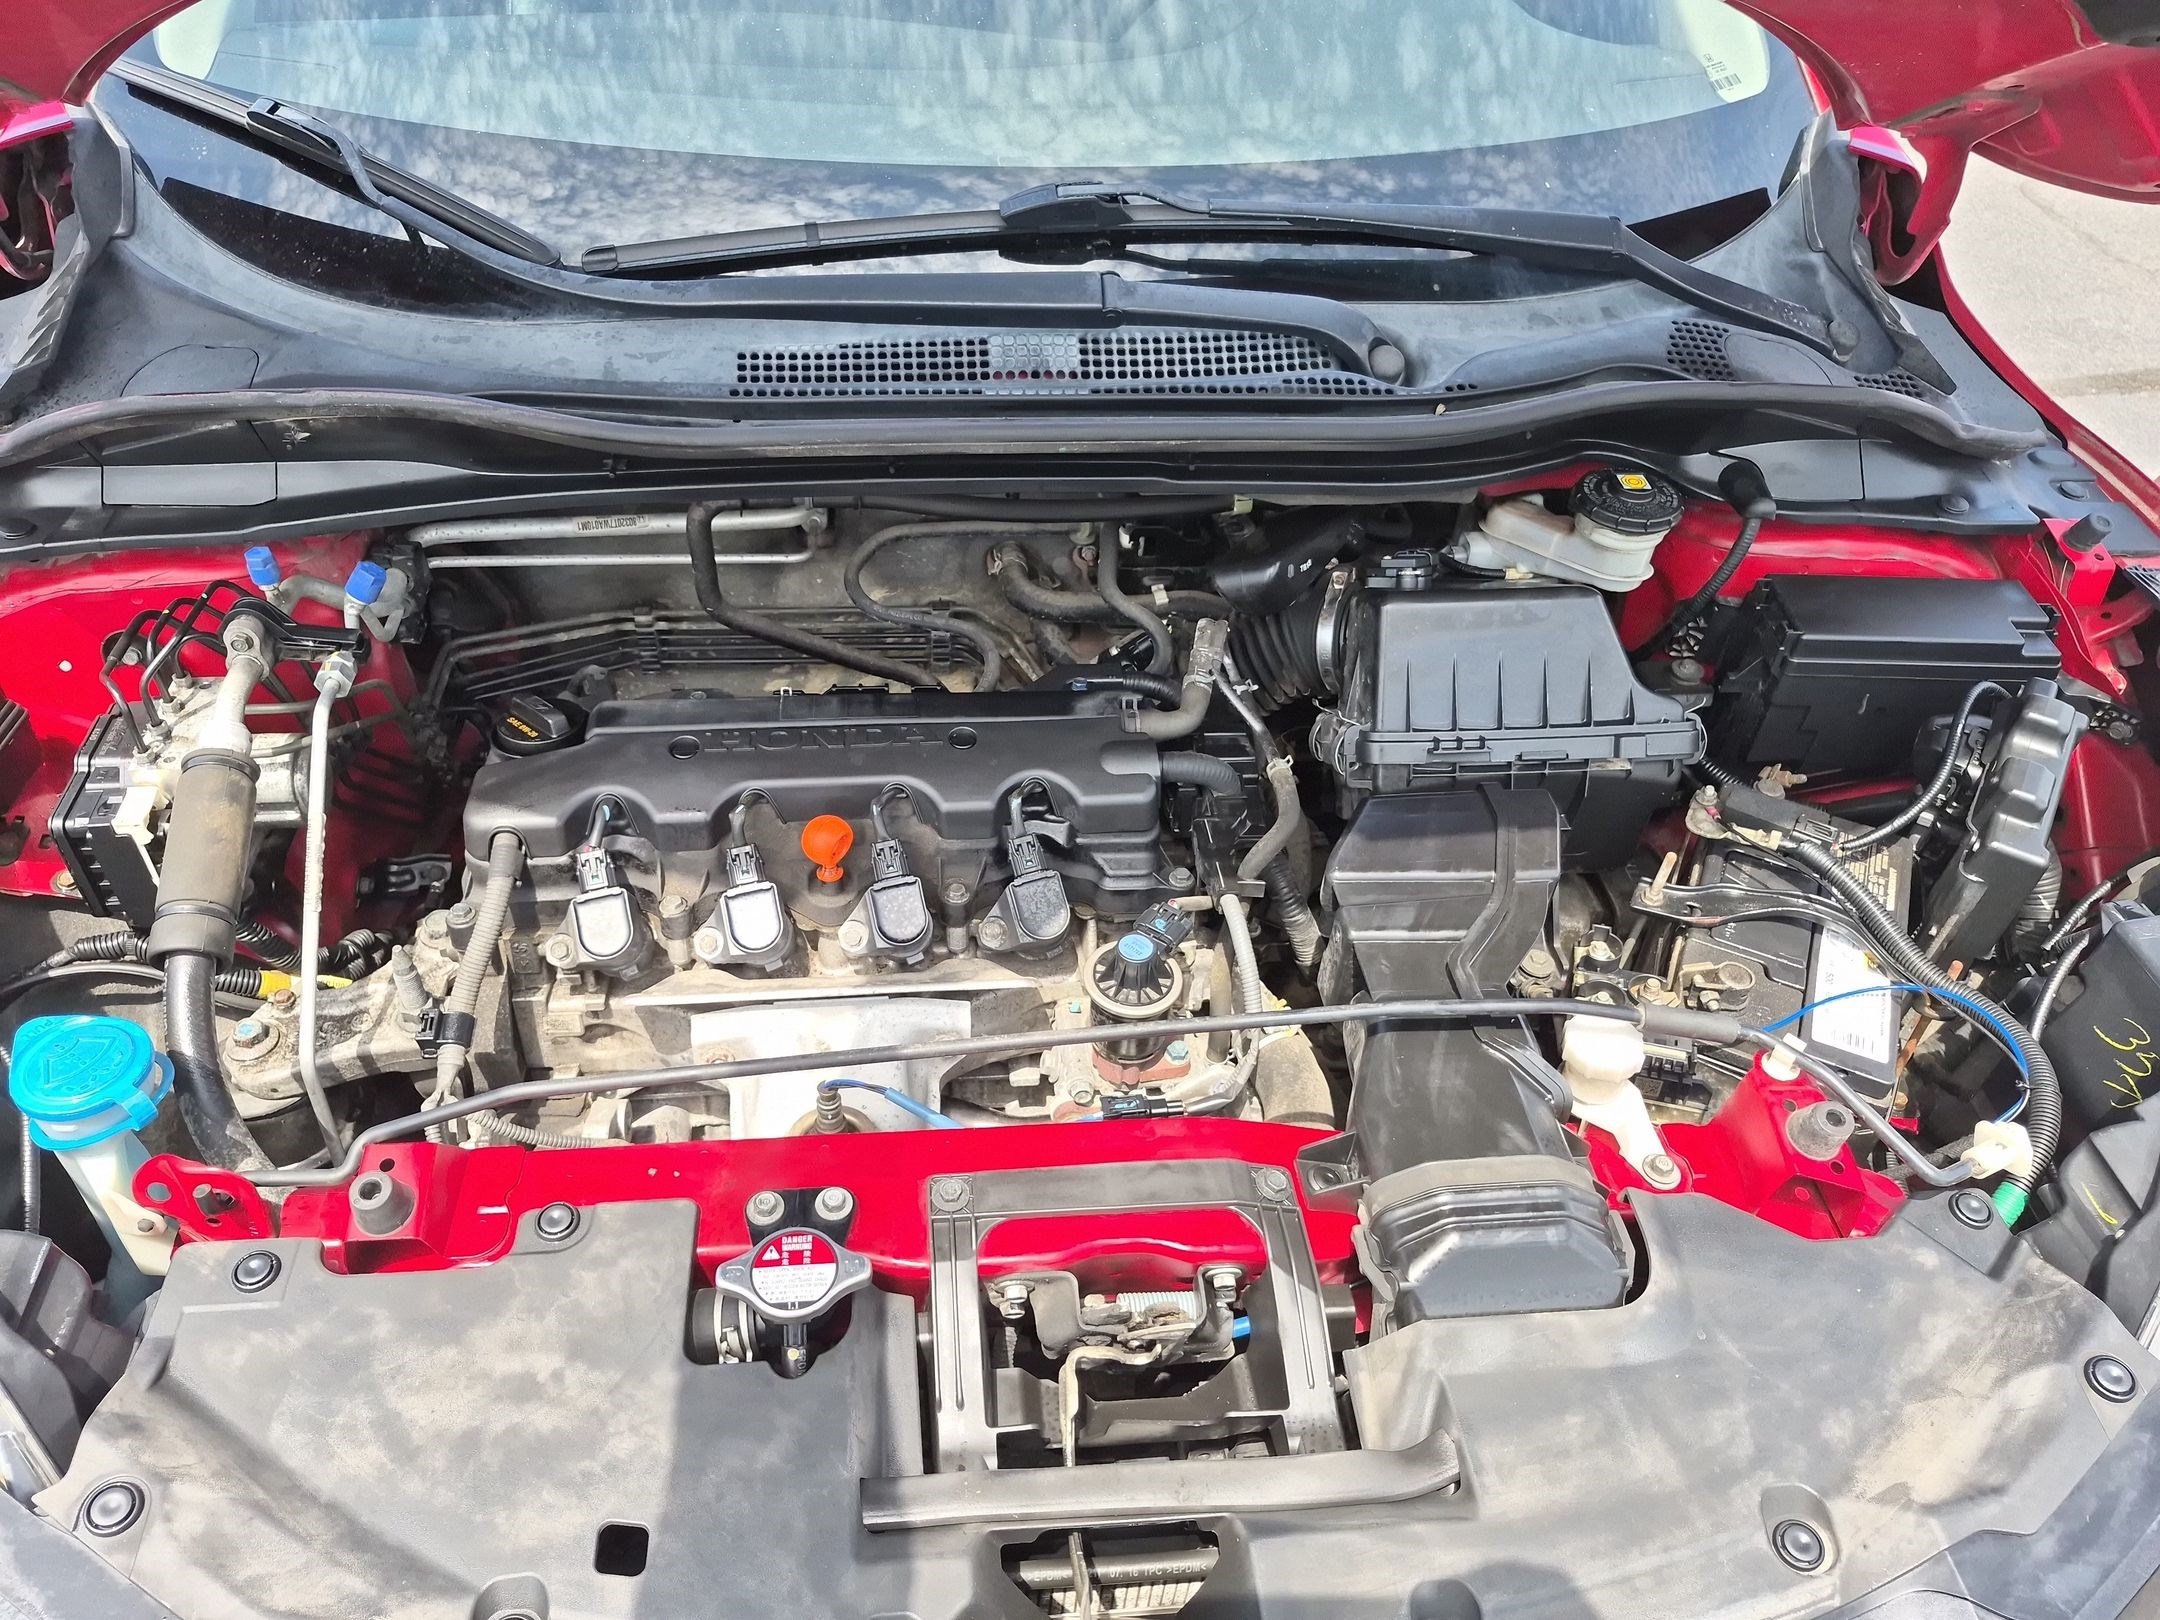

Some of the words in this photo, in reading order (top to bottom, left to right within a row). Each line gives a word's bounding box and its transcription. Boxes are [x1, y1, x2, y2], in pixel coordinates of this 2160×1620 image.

[506, 716, 523, 728] SAE
[703, 726, 944, 751] HONDA
[781, 1234, 813, 1244] DANGER
[787, 1300, 799, 1310] 1.1
[1143, 1566, 1163, 1576] TPC
